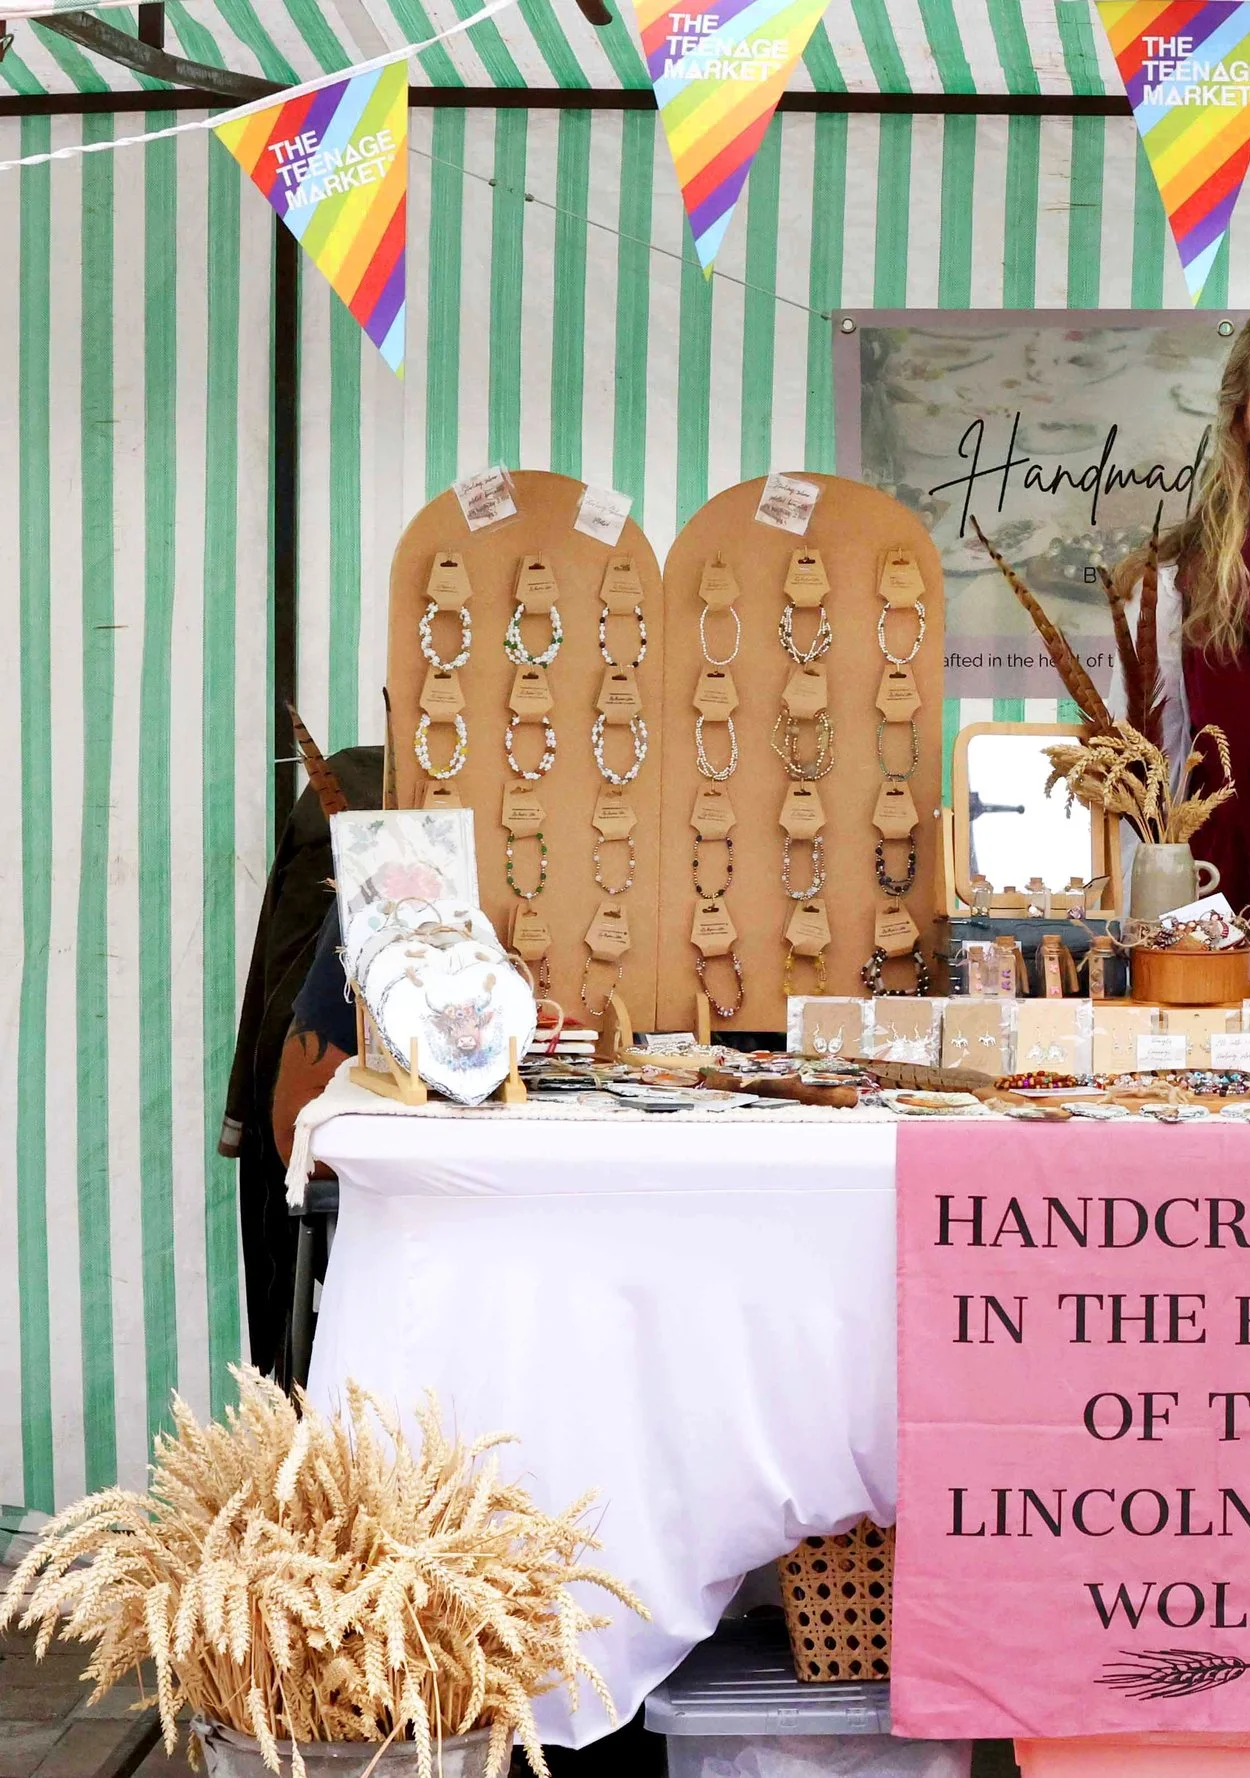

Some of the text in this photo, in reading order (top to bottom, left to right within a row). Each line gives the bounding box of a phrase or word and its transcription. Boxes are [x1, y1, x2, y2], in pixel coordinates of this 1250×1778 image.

[669, 13, 719, 34] THE
[666, 36, 788, 59] TEENAGE
[1142, 36, 1193, 57] THE
[268, 130, 319, 164] THE
[276, 130, 396, 187] TEENAGE
[928, 411, 1212, 537] Handmad
[943, 653, 983, 668] afted
[988, 653, 1002, 668] in
[1007, 653, 1034, 668] the
[1086, 653, 1104, 668] of
[952, 1295, 1029, 1344] IN
[1058, 1293, 1206, 1344] THE
[1083, 1391, 1179, 1441] OF
